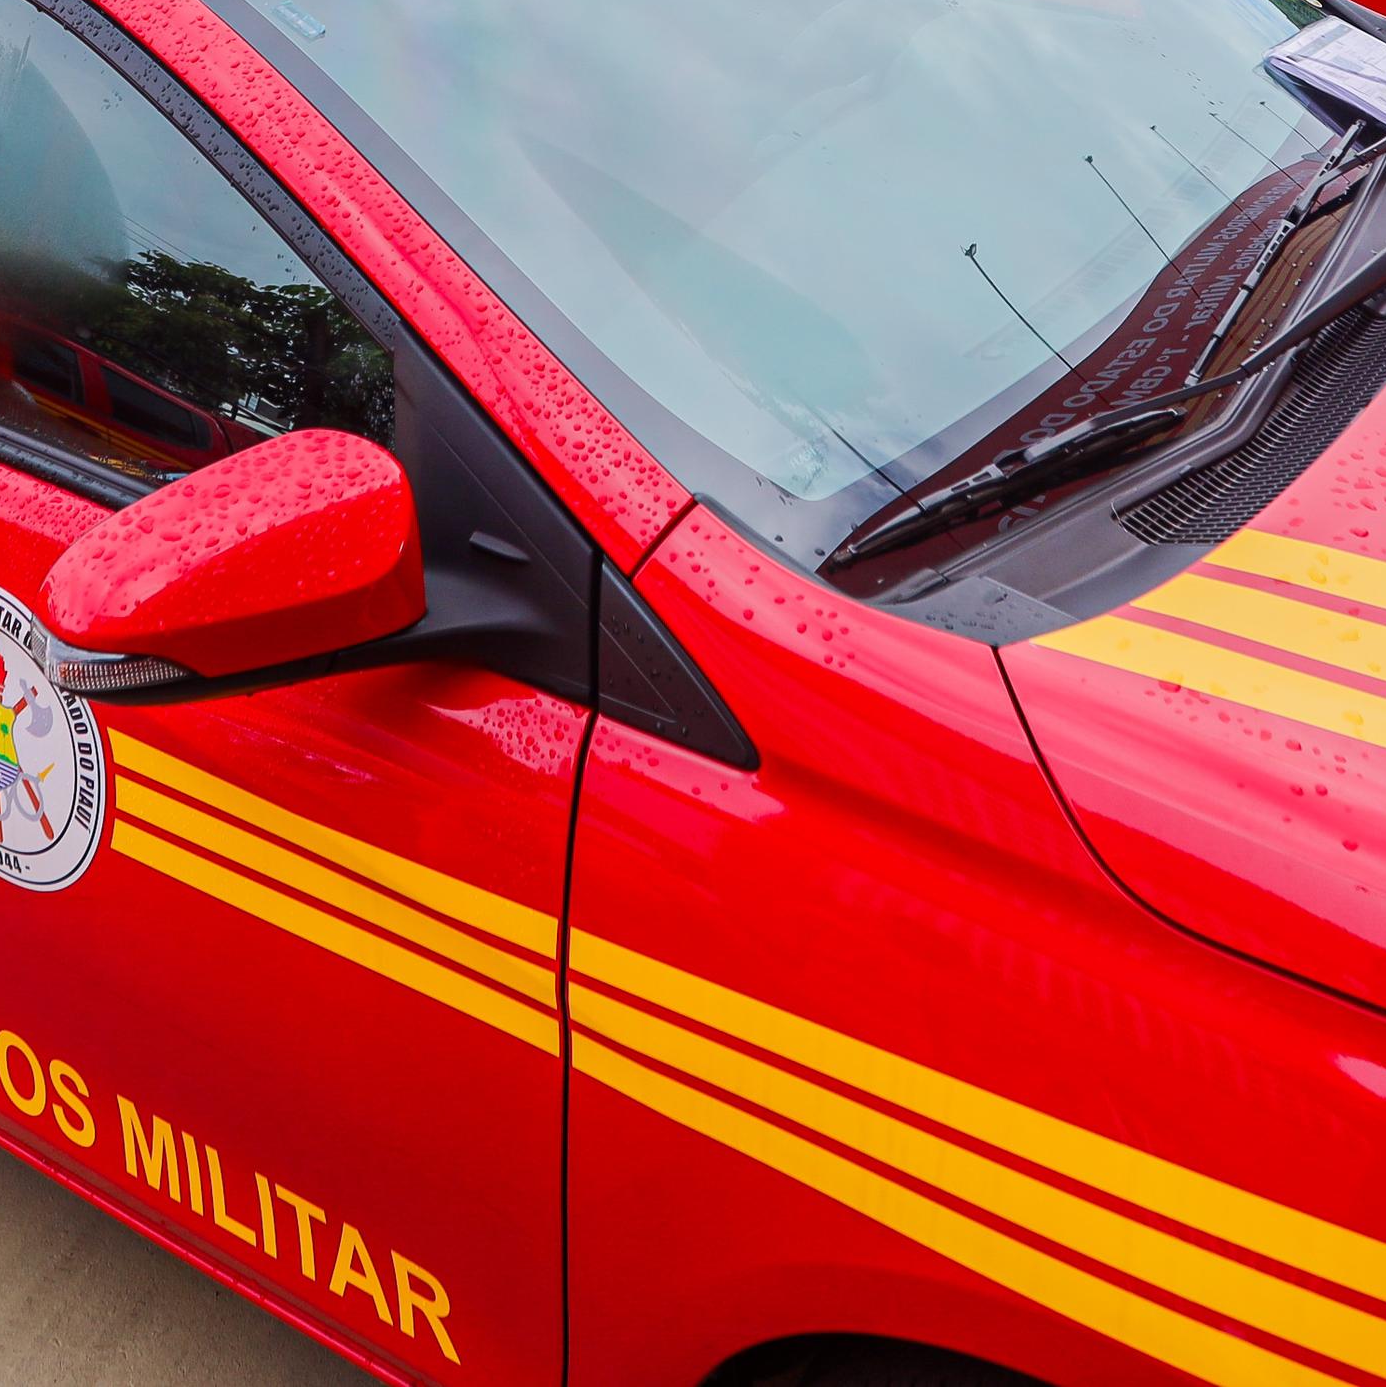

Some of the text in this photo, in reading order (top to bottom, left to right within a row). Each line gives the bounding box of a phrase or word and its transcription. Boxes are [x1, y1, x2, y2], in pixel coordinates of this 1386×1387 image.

[61, 688, 89, 734] ADO
[77, 741, 94, 771] DO
[117, 1094, 461, 1366] MILITAR
